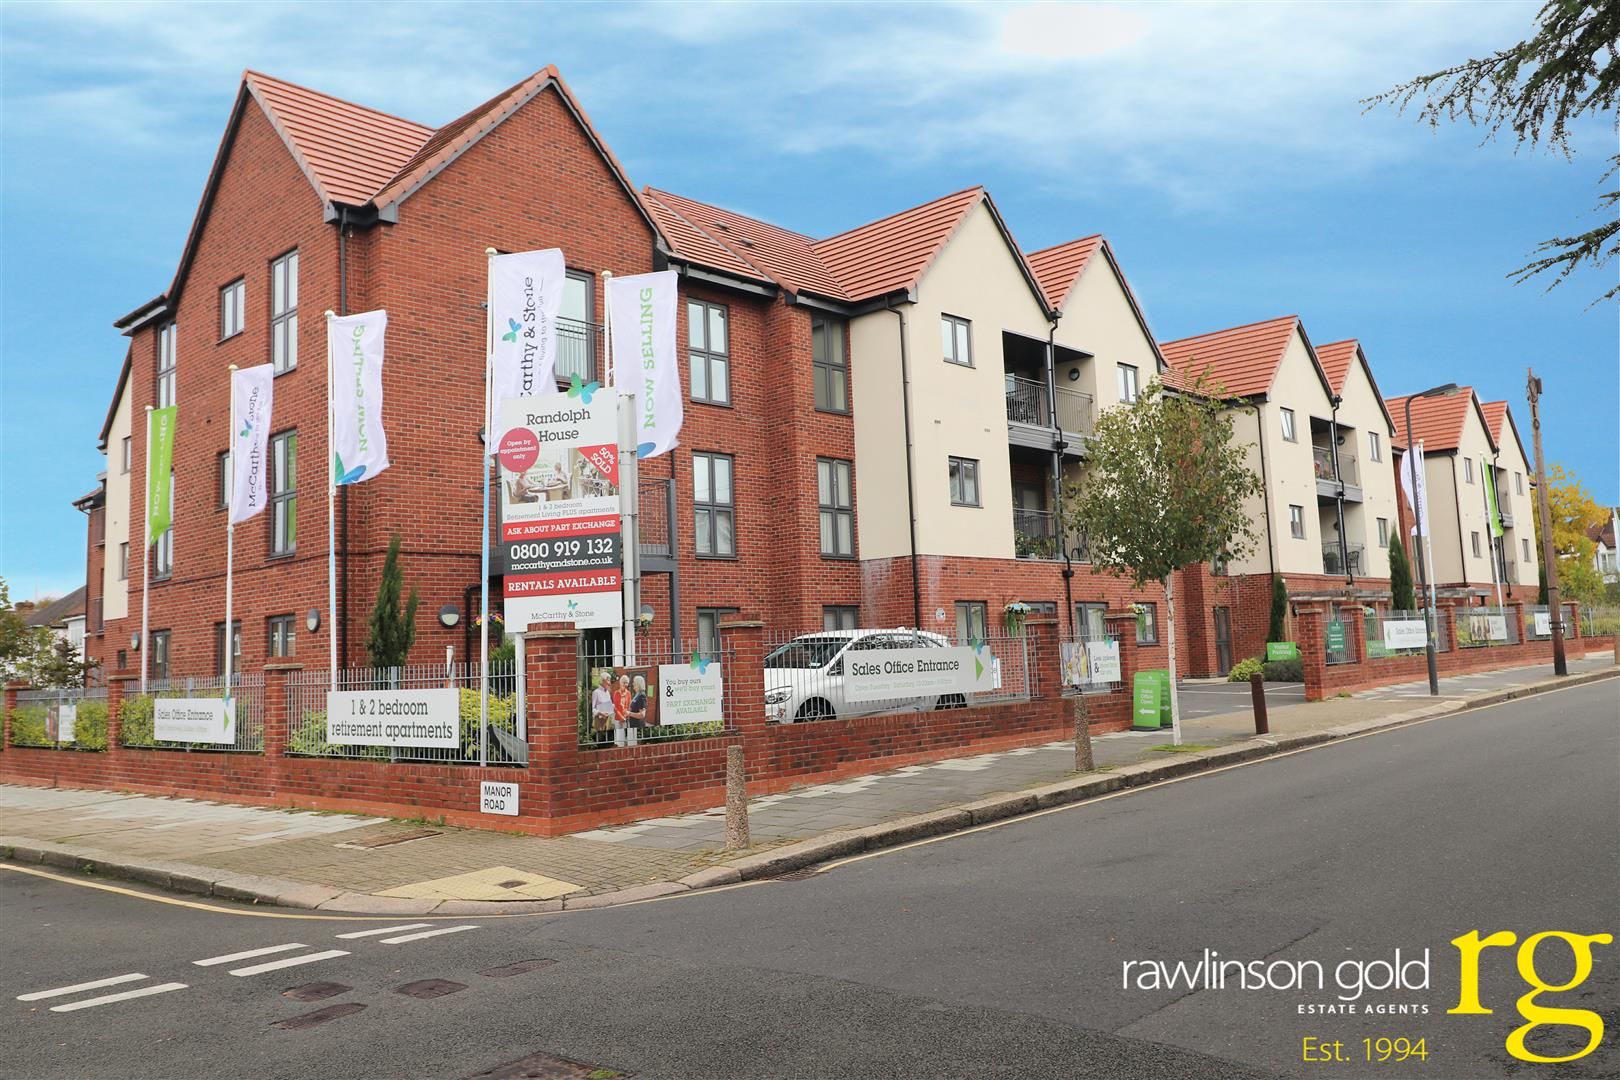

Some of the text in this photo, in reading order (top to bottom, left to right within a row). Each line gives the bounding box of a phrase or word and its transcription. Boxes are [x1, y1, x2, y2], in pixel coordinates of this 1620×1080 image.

[520, 276, 538, 398] arthy & Stone
[640, 287, 656, 429] NOW SELLING
[525, 408, 592, 426] Randolph
[538, 429, 580, 443] House
[500, 446, 537, 454] appointment
[512, 453, 526, 461] only
[599, 446, 616, 465] 50%
[590, 452, 613, 474] SOLD
[248, 442, 260, 508] McCarth
[506, 506, 616, 521] Retirement Living PLUS apartments
[554, 501, 583, 510] bedroom
[506, 519, 616, 536] ASK ABOUT PART EXCHANGE
[510, 537, 614, 560] 0800 919 132
[511, 555, 613, 571] mccarthyandstone.co.uk
[507, 575, 617, 592] RENTALS AVAILABLE
[531, 612, 568, 621] McCarthy
[574, 610, 595, 618] Stone
[852, 658, 960, 676] Sales Office Entrance
[1094, 662, 1100, 673] &
[665, 685, 674, 697] &
[351, 698, 429, 716] 1 & 2 bedroom
[675, 705, 708, 715] AVAILABLE
[682, 697, 716, 707] EXCHANGE
[331, 720, 453, 742] retirement apartments
[484, 785, 512, 798] MANOR
[483, 798, 505, 811] ROAD
